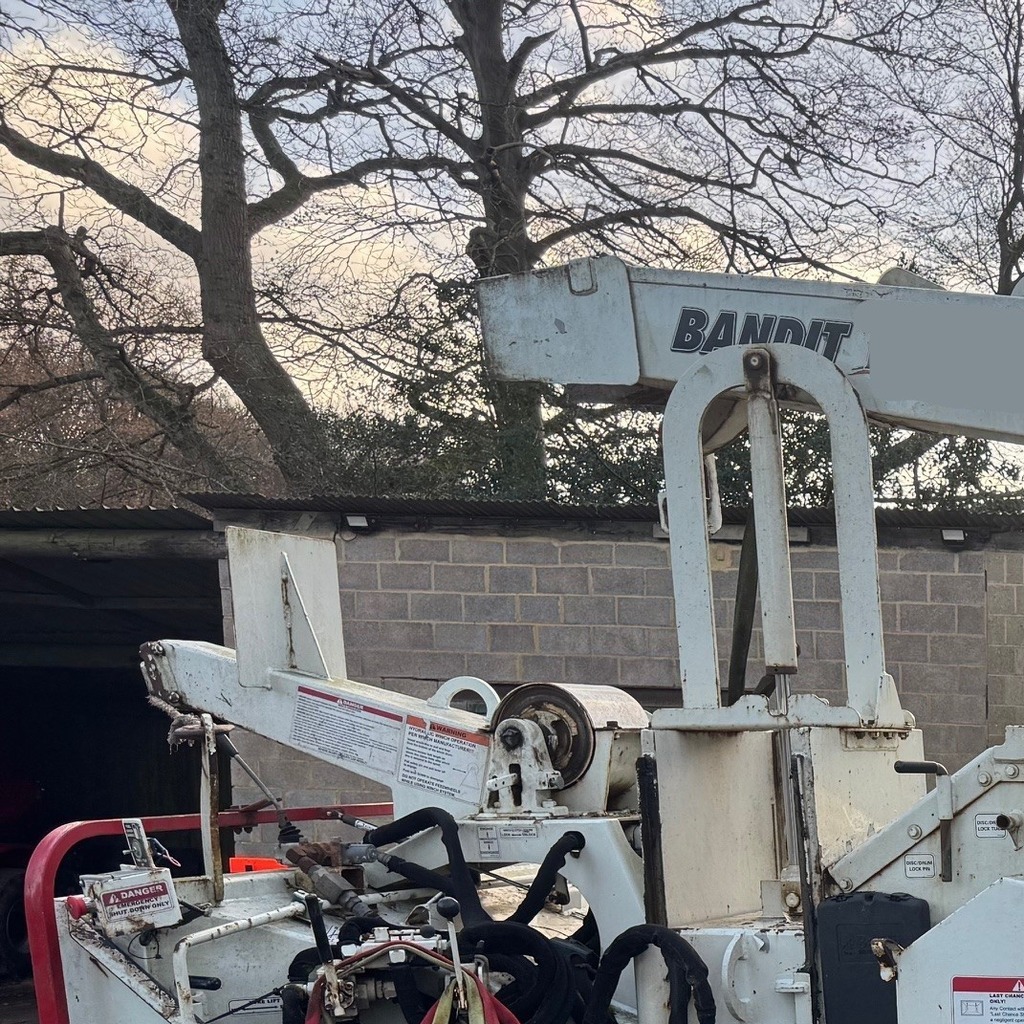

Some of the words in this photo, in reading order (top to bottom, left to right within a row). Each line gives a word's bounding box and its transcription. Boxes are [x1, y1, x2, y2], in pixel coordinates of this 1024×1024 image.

[670, 307, 852, 363] BANDIT
[436, 725, 466, 737] WARNING
[121, 885, 163, 898] DANGER
[117, 897, 159, 908] EMERGENCY
